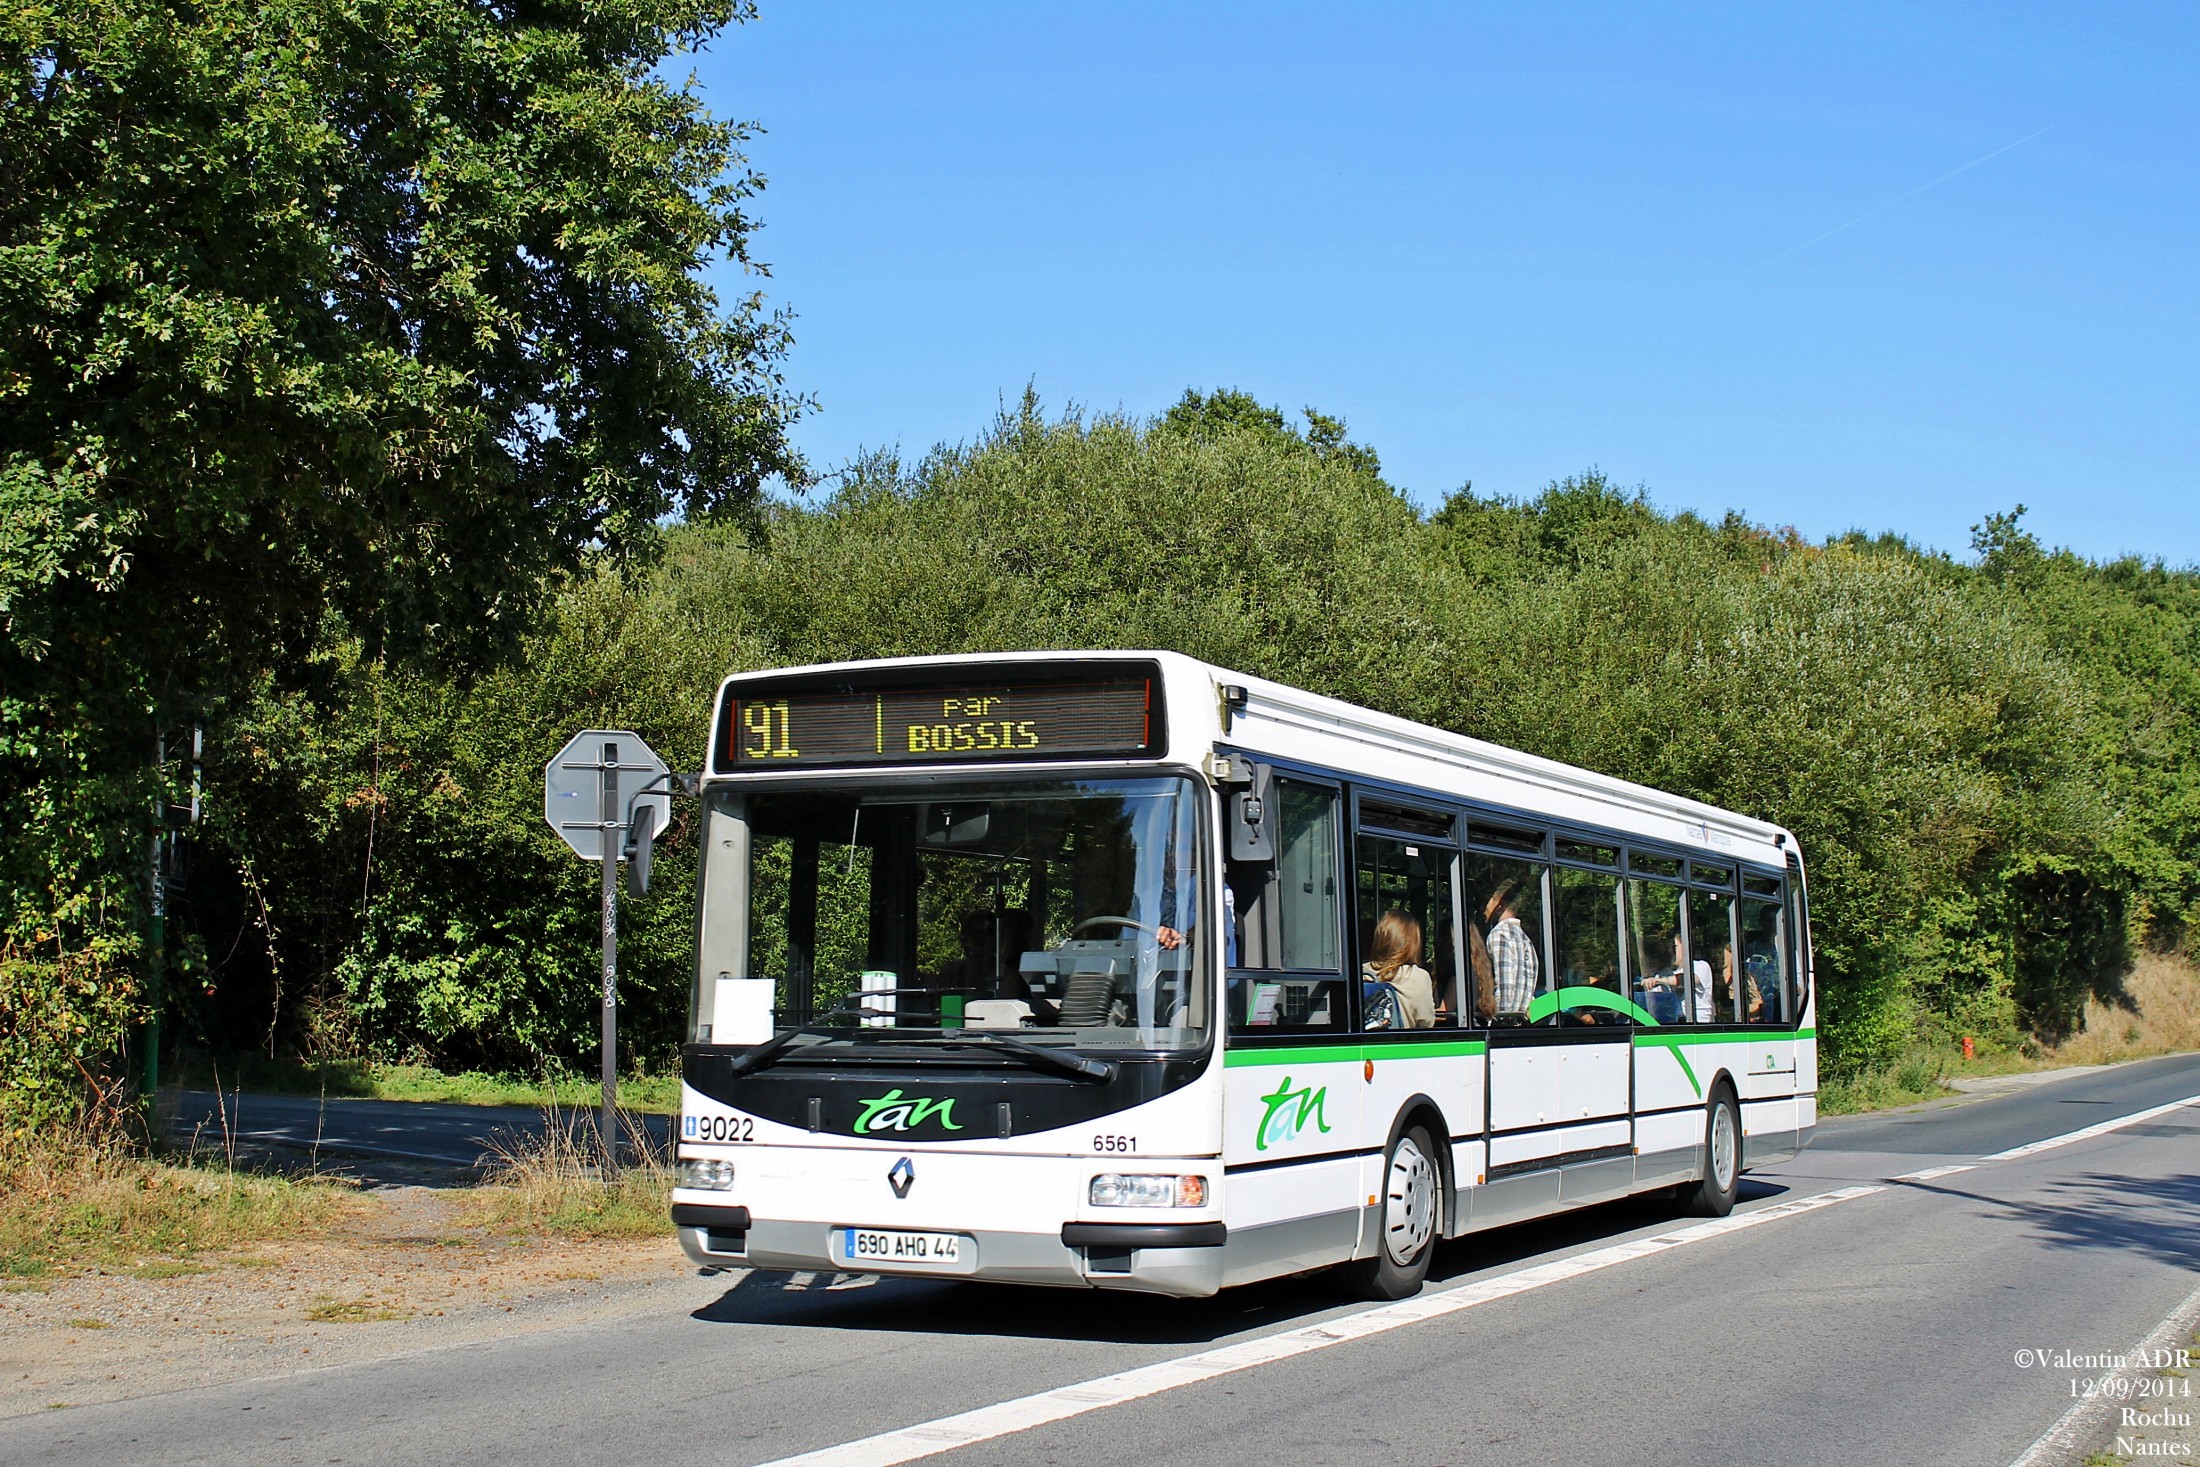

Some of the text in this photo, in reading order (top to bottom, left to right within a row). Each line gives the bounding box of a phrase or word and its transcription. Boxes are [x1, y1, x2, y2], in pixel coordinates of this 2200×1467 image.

[744, 700, 799, 758] 91
[908, 721, 1039, 752] BOSSIS
[853, 1089, 964, 1134] tan
[1256, 1075, 1331, 1151] tan
[700, 1116, 754, 1141] 9022
[1093, 1134, 1136, 1152] 6561
[858, 1233, 956, 1257] 690 AHQ 44
